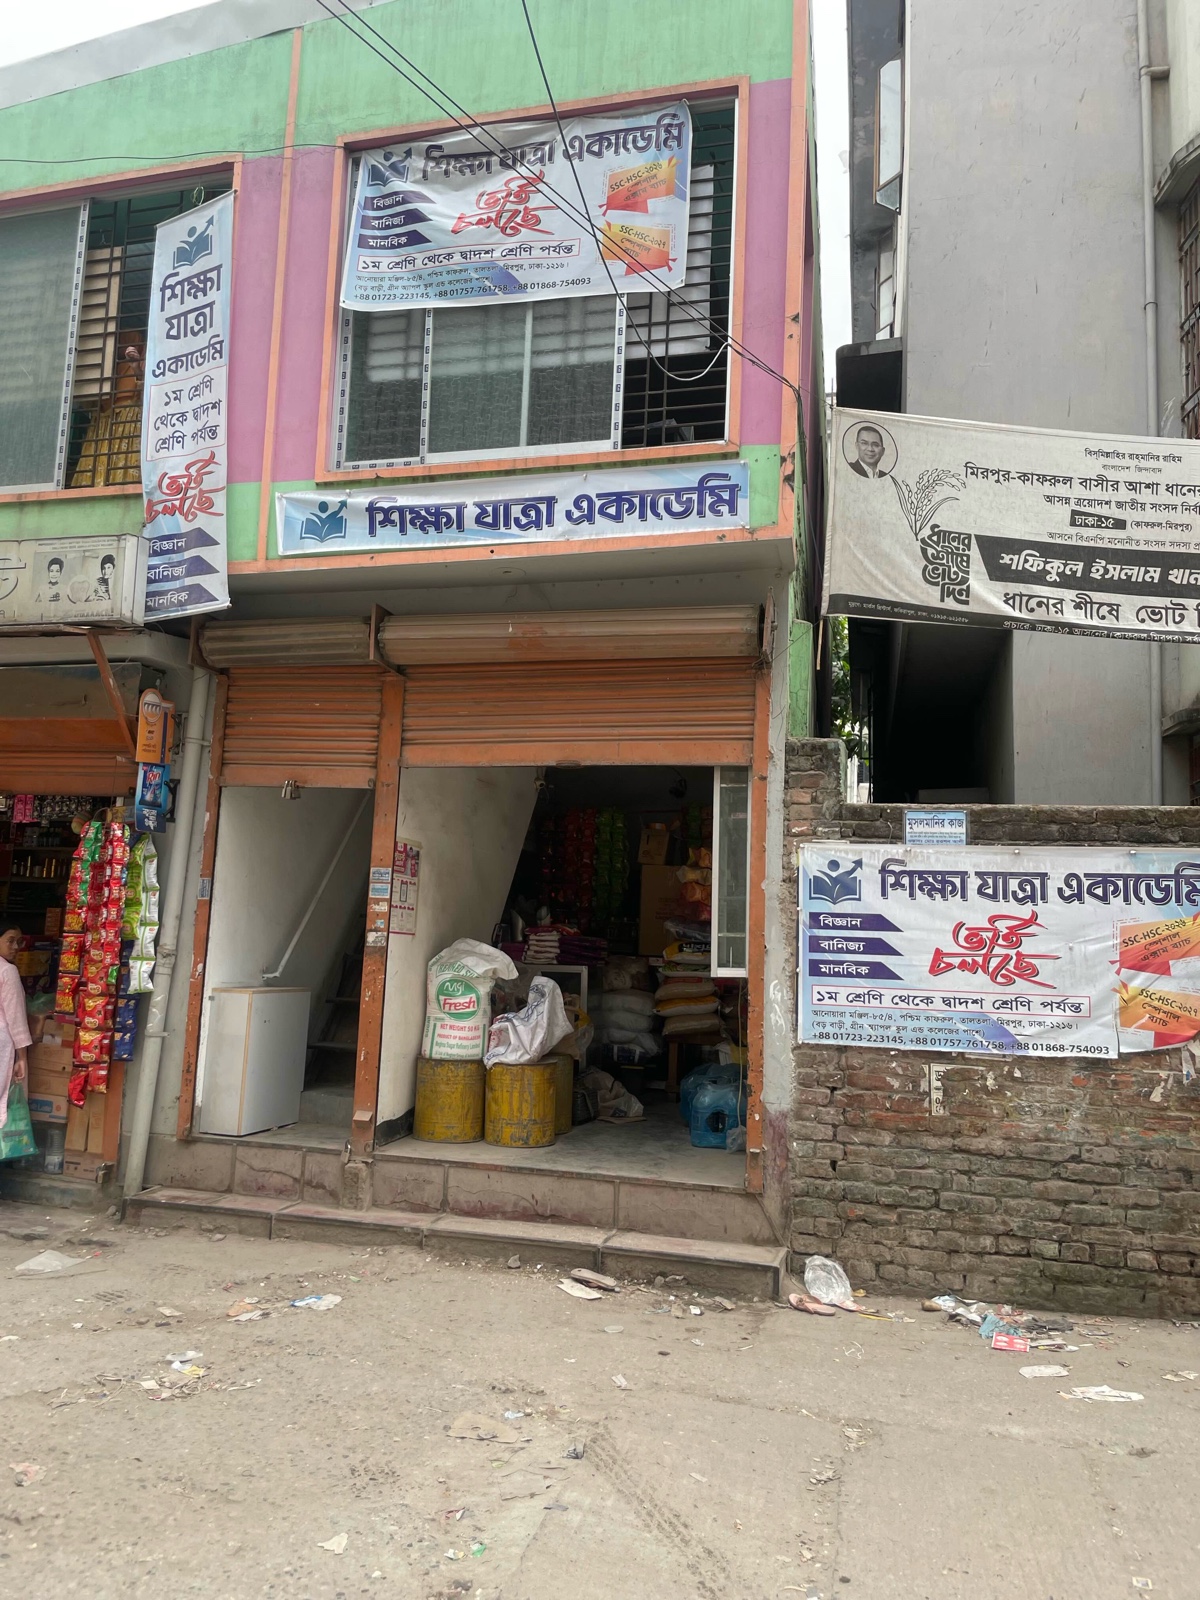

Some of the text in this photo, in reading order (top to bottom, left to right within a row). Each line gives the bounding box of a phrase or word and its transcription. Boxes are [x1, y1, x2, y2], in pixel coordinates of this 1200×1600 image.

[422, 113, 686, 181] শিক্ষা যাত্রা একাডেমি
[475, 168, 552, 211] ভর্তি
[373, 195, 404, 209] বিজ্ঞান
[370, 215, 405, 229] বানিজ্য
[451, 205, 558, 237] চলছে
[367, 236, 408, 249] মানবিক
[361, 242, 576, 271] ১ম শ্রেণি থেকে দ্বাদশ শ্রেণি পর্যন্ত
[160, 264, 223, 312] শিক্ষা
[530, 277, 591, 290] 01868-754093
[165, 301, 215, 340] যাত্রা
[152, 334, 224, 378] একাডেমি
[164, 375, 214, 406] ১ম শ্রেণি
[154, 398, 222, 431] থেকে দ্বাদশ
[155, 420, 220, 453] শ্রেণি পর্যন্ত
[1102, 464, 1162, 474] বাংলাদেশ জিন্দাবাদ
[1162, 454, 1182, 463] রাহিম
[158, 450, 221, 496] ভর্তি
[963, 462, 1073, 489] মিরপুর-কাফরুল
[1078, 474, 1120, 493] বাসীর
[1124, 480, 1161, 496] আশা
[145, 486, 225, 524] চলছে
[365, 473, 741, 537] শিক্ষা যাত্রা একাডেমি
[1043, 494, 1071, 507] আসন্ন
[1074, 497, 1112, 509] ত্রয়োদশ
[1115, 498, 1146, 512] জাতীয়
[1150, 503, 1178, 513] সংসদ
[1074, 515, 1193, 532] ঢাকা-১৫ (কাফরুল-মিরপুর)
[150, 537, 186, 554] বিজ্ঞান
[1047, 531, 1073, 542] আসনে
[1075, 532, 1105, 544] বিএনপি
[1107, 536, 1140, 547] মনোনীত
[1143, 540, 1166, 549] সংসদ
[1169, 542, 1191, 550] সদস্য
[147, 564, 187, 580] বানিজ্য
[999, 550, 1200, 586] শফিকুল ইসলাম খান
[146, 590, 189, 608] মানবিক
[1003, 591, 1066, 616] ধানের
[1069, 593, 1121, 623] শীষে
[1136, 599, 1189, 627] ভোট
[907, 814, 965, 830] মুসলমানির কাজ
[878, 858, 970, 901] শিক্ষা
[975, 871, 1050, 906] যাত্রা
[819, 914, 862, 928] বিজ্ঞান
[952, 909, 1048, 951] ভর্তি
[1122, 918, 1187, 948] SSC-HSC-২০২৬
[1144, 931, 1181, 952] স্পেশাল
[1171, 937, 1191, 950] ব্যাচ
[819, 937, 866, 952] বানিজ্য
[819, 963, 870, 976] মানবিক
[928, 947, 1062, 989] চলছে
[442, 997, 476, 1012] Fresh
[816, 989, 1084, 1014] ১ম শ্রেণি থেকে দ্বাদশ শ্রেণি পর্যন্ত
[1138, 988, 1199, 1018] SSC-HSC-২০২৭
[1142, 1001, 1181, 1023] স্পেশাল
[449, 1024, 466, 1032] WEIGHT
[811, 1009, 846, 1018] আনোয়ারা
[899, 1013, 921, 1022] পশ্চিম
[923, 1015, 957, 1025] কাফরুল,
[960, 1017, 994, 1026] তালতলা,
[997, 1017, 1025, 1029] মিরপুর,
[1148, 1013, 1170, 1027] ব্যাচ
[927, 1027, 959, 1035] কলেজের
[812, 1032, 1110, 1055] +88 01723-223145, +88 01757-761758, +88 01868-754093
